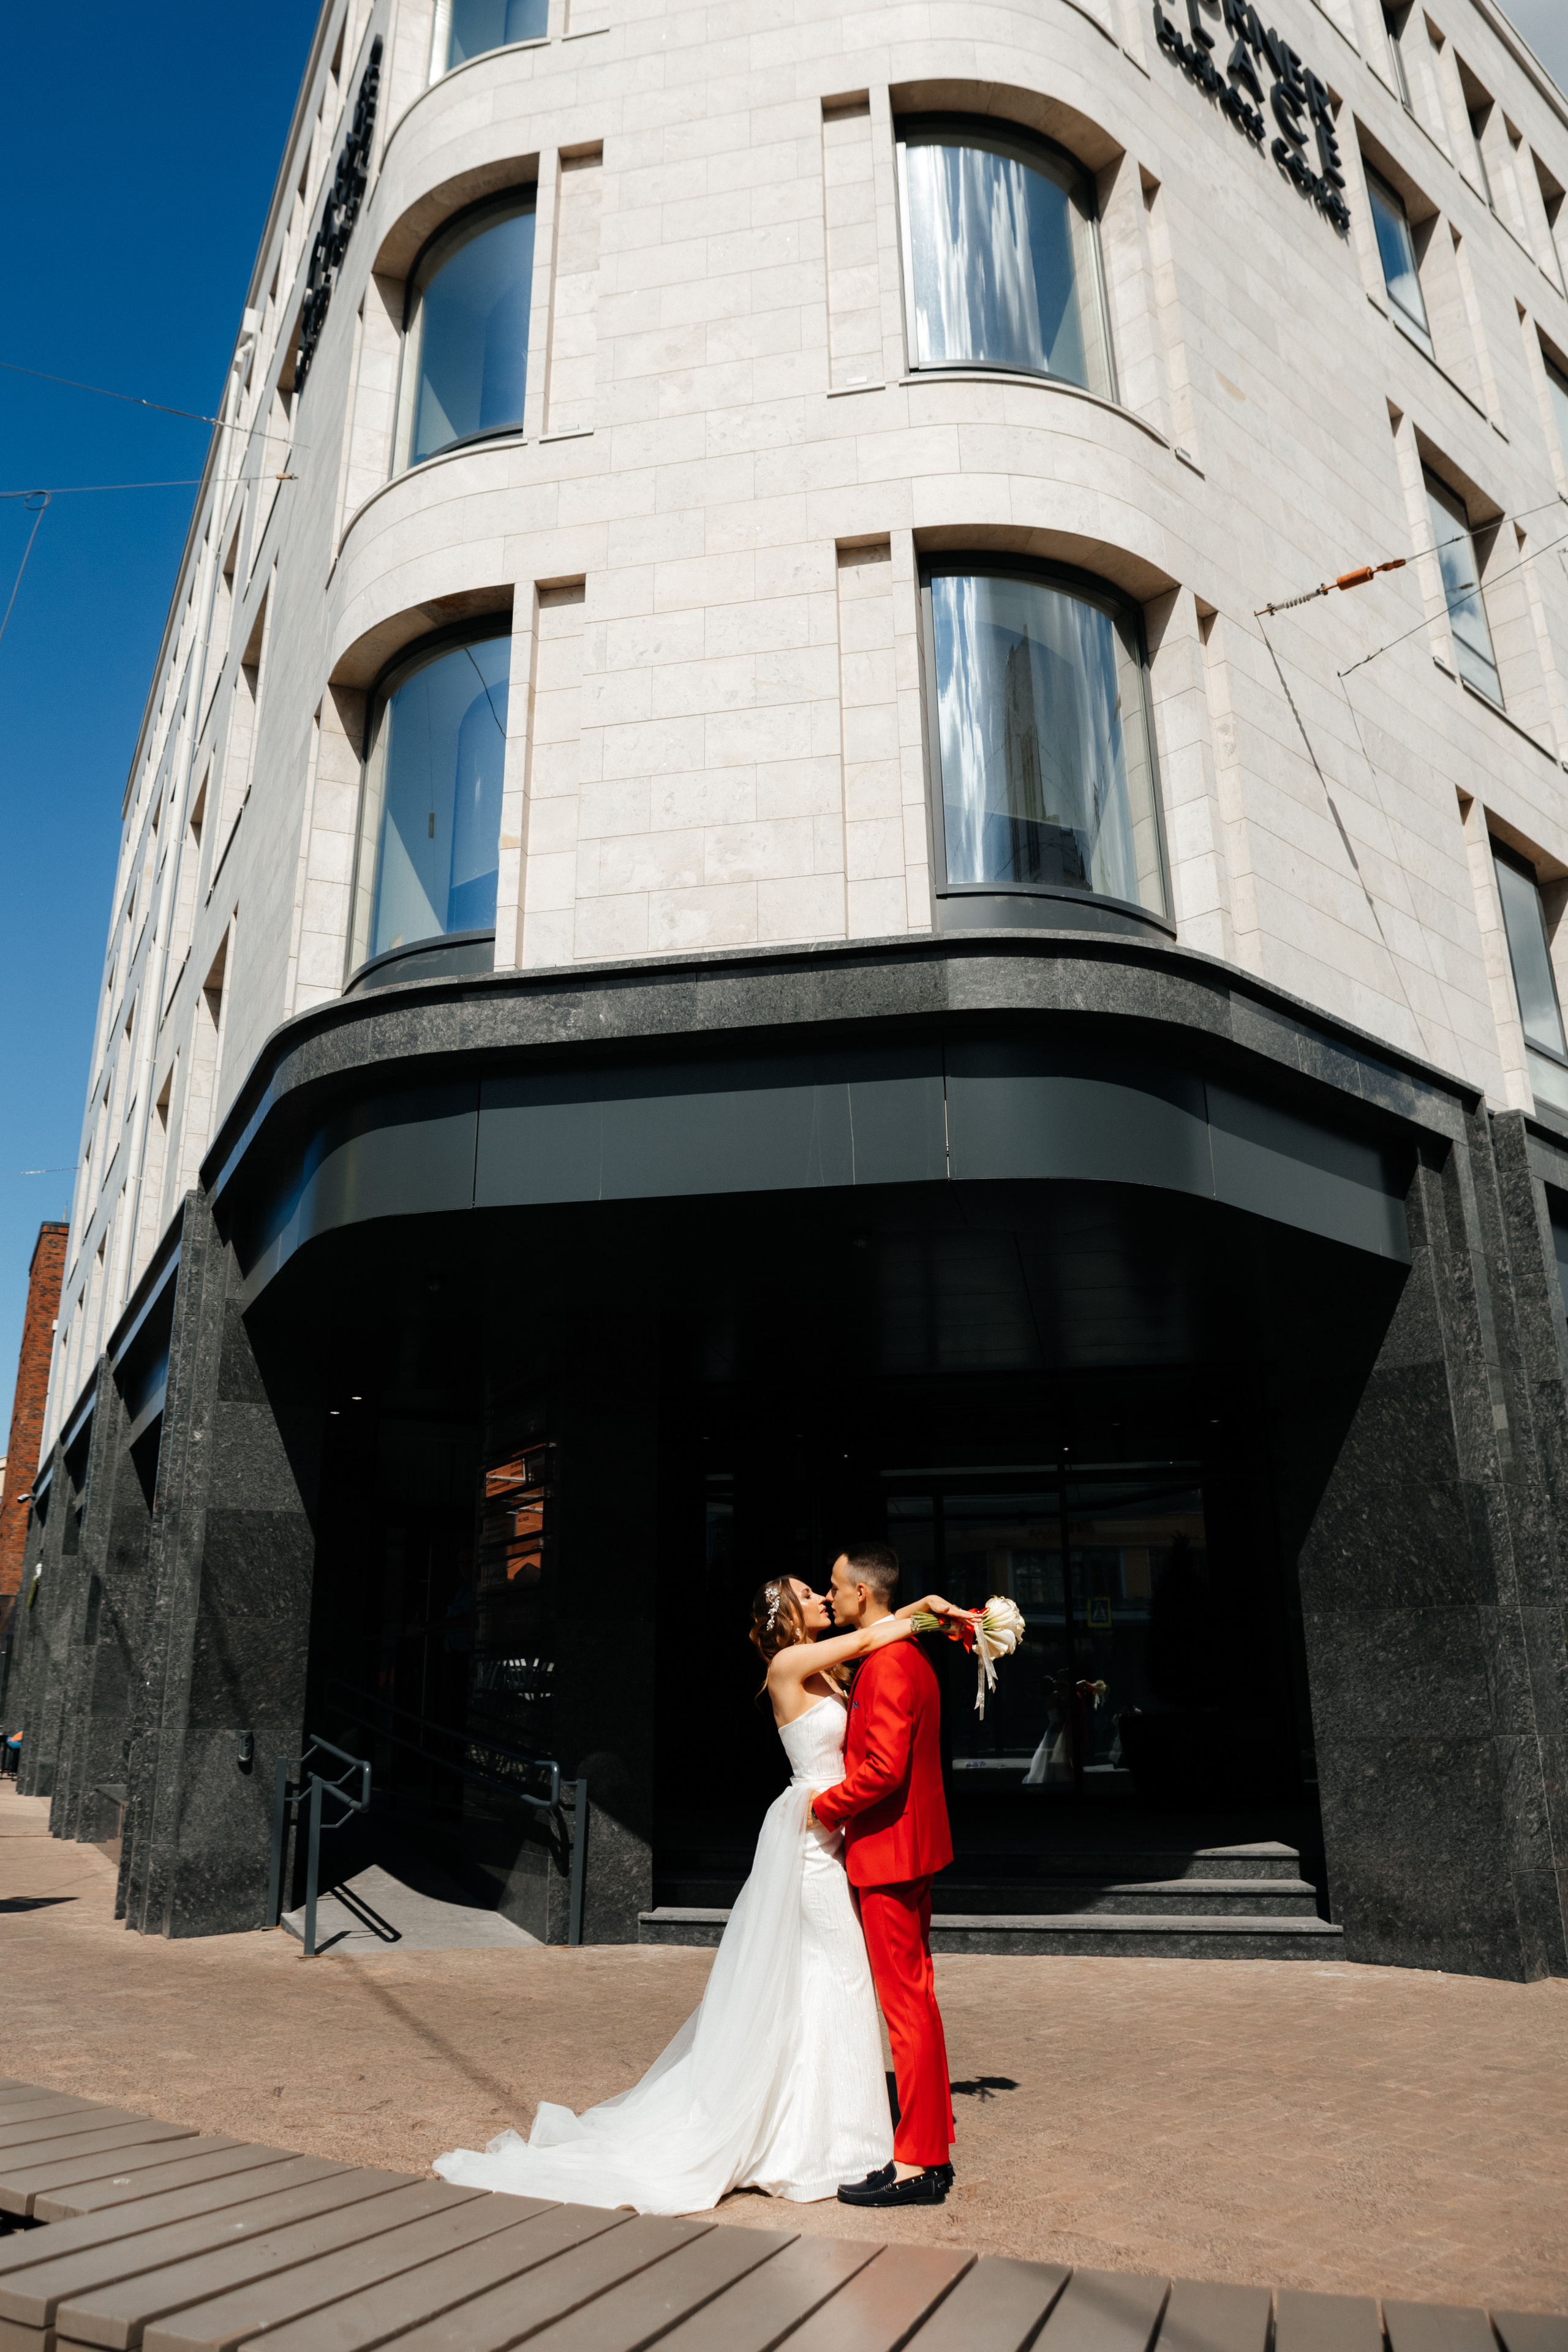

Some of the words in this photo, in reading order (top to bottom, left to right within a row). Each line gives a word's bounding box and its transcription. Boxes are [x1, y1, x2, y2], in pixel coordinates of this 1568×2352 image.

[1153, 0, 1266, 142] business
[1186, 0, 1346, 189] LACE
[1223, 0, 1336, 133] RNER
